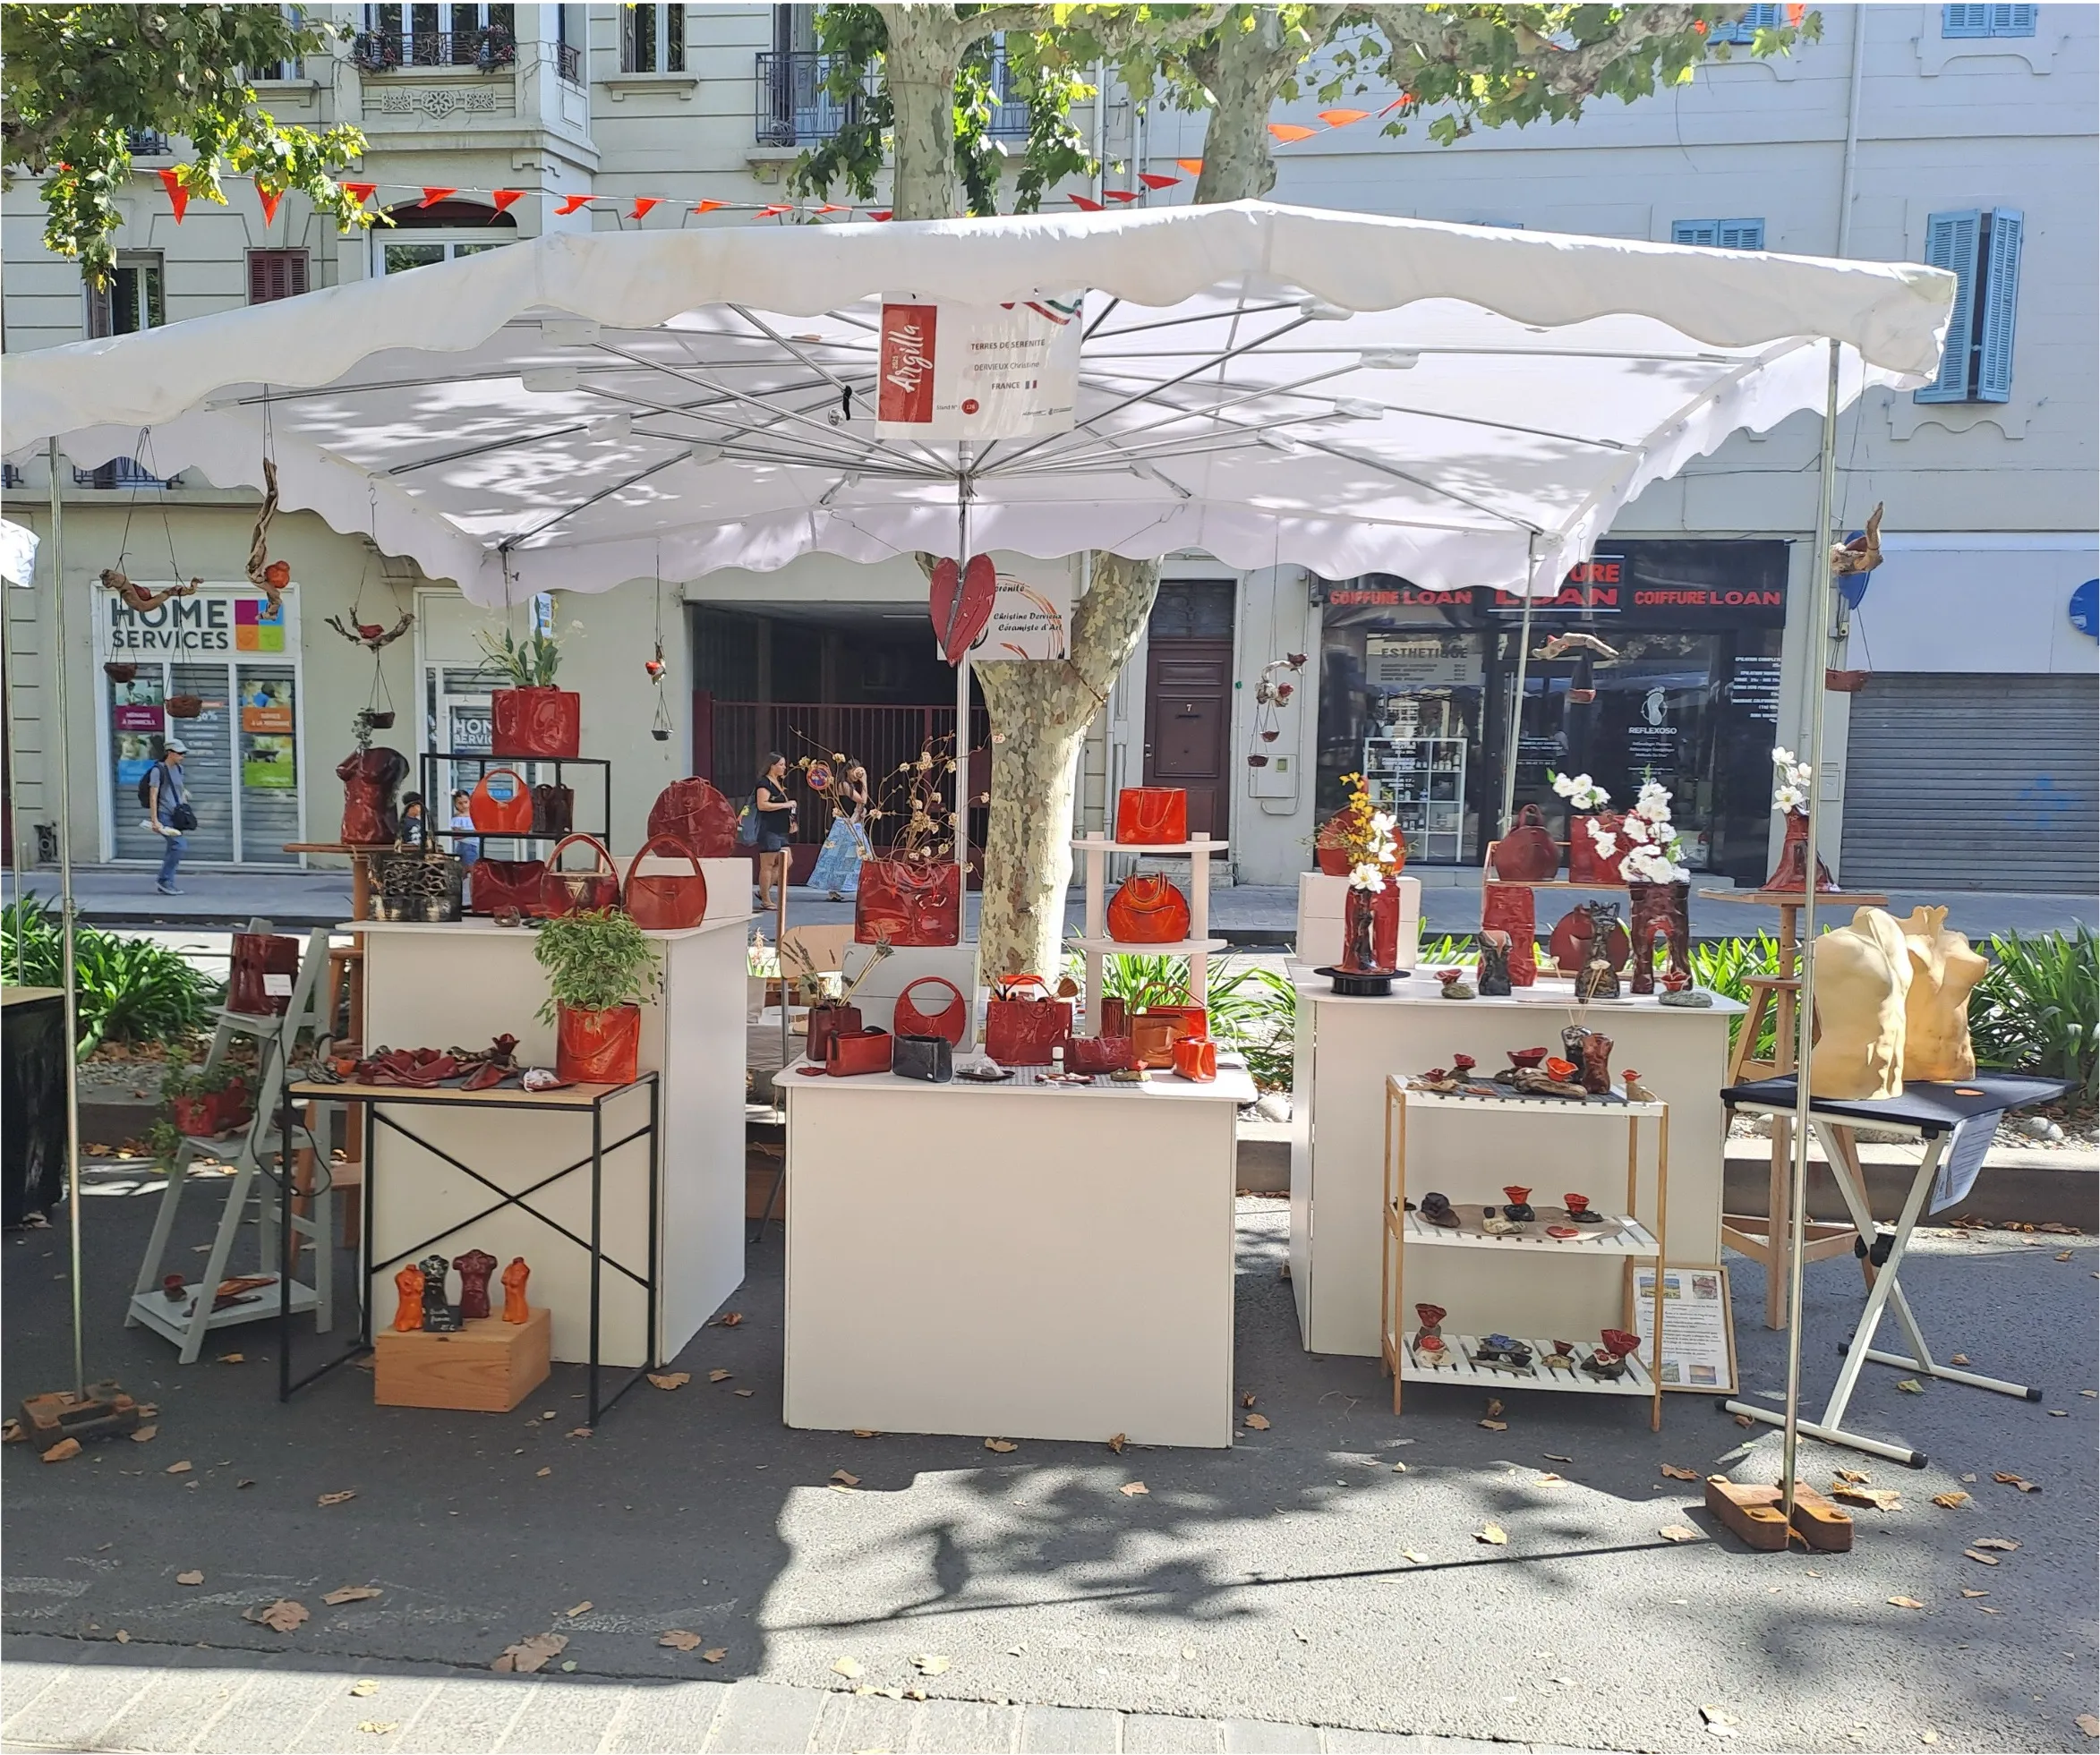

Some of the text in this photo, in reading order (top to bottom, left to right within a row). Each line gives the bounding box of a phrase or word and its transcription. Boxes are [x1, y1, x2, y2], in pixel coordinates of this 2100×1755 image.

[999, 341, 1010, 349] DE
[886, 325, 933, 393] Argilla
[974, 362, 1039, 371] DERVIEUX Christine
[991, 381, 1020, 389] FRANCE
[995, 584, 1025, 592] érénité
[1329, 590, 1473, 605] COIFFURE LOAN
[1635, 591, 1780, 605] COIFFURE LOAN
[111, 598, 228, 628] HOME
[994, 612, 1063, 620] Christine Dervieux
[998, 623, 1038, 632] Céramiste
[112, 630, 228, 650] SERVICES
[1381, 647, 1468, 660] ESTHETIQUE
[1186, 703, 1192, 712] 7
[1628, 727, 1678, 735] REFLEXOSO
